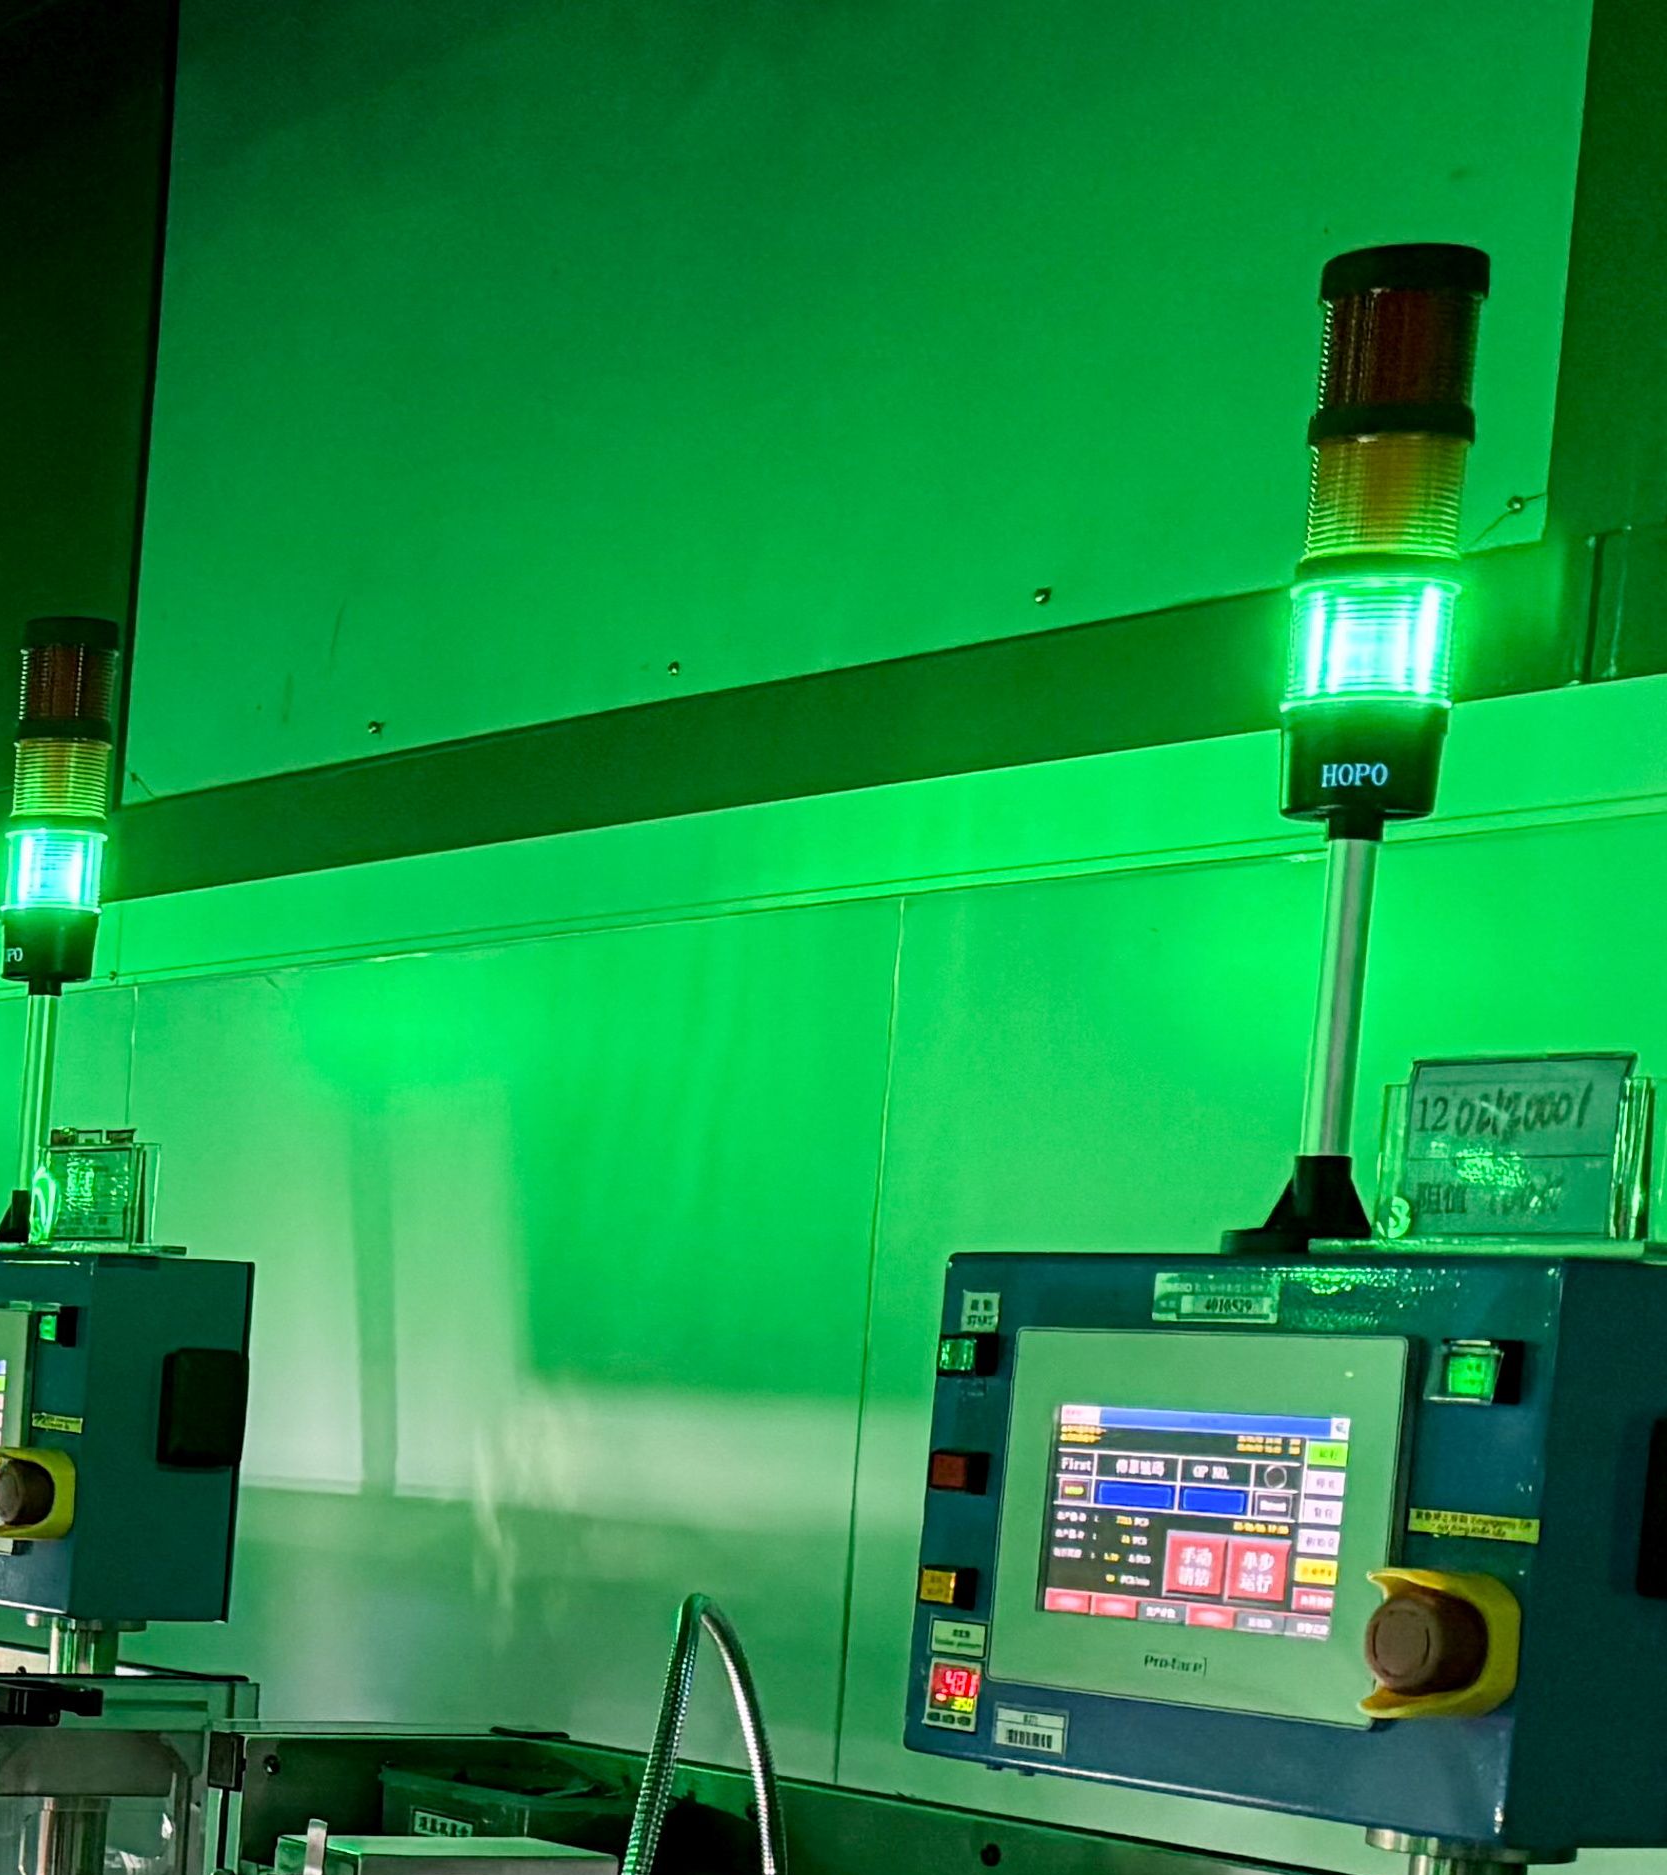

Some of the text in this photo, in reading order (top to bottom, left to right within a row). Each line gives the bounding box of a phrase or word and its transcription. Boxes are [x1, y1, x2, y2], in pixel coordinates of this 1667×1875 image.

[1321, 763, 1388, 787] HOPO
[1061, 1457, 1092, 1472] First
[1181, 1547, 1213, 1567] 手动
[1239, 1573, 1273, 1593] 运行
